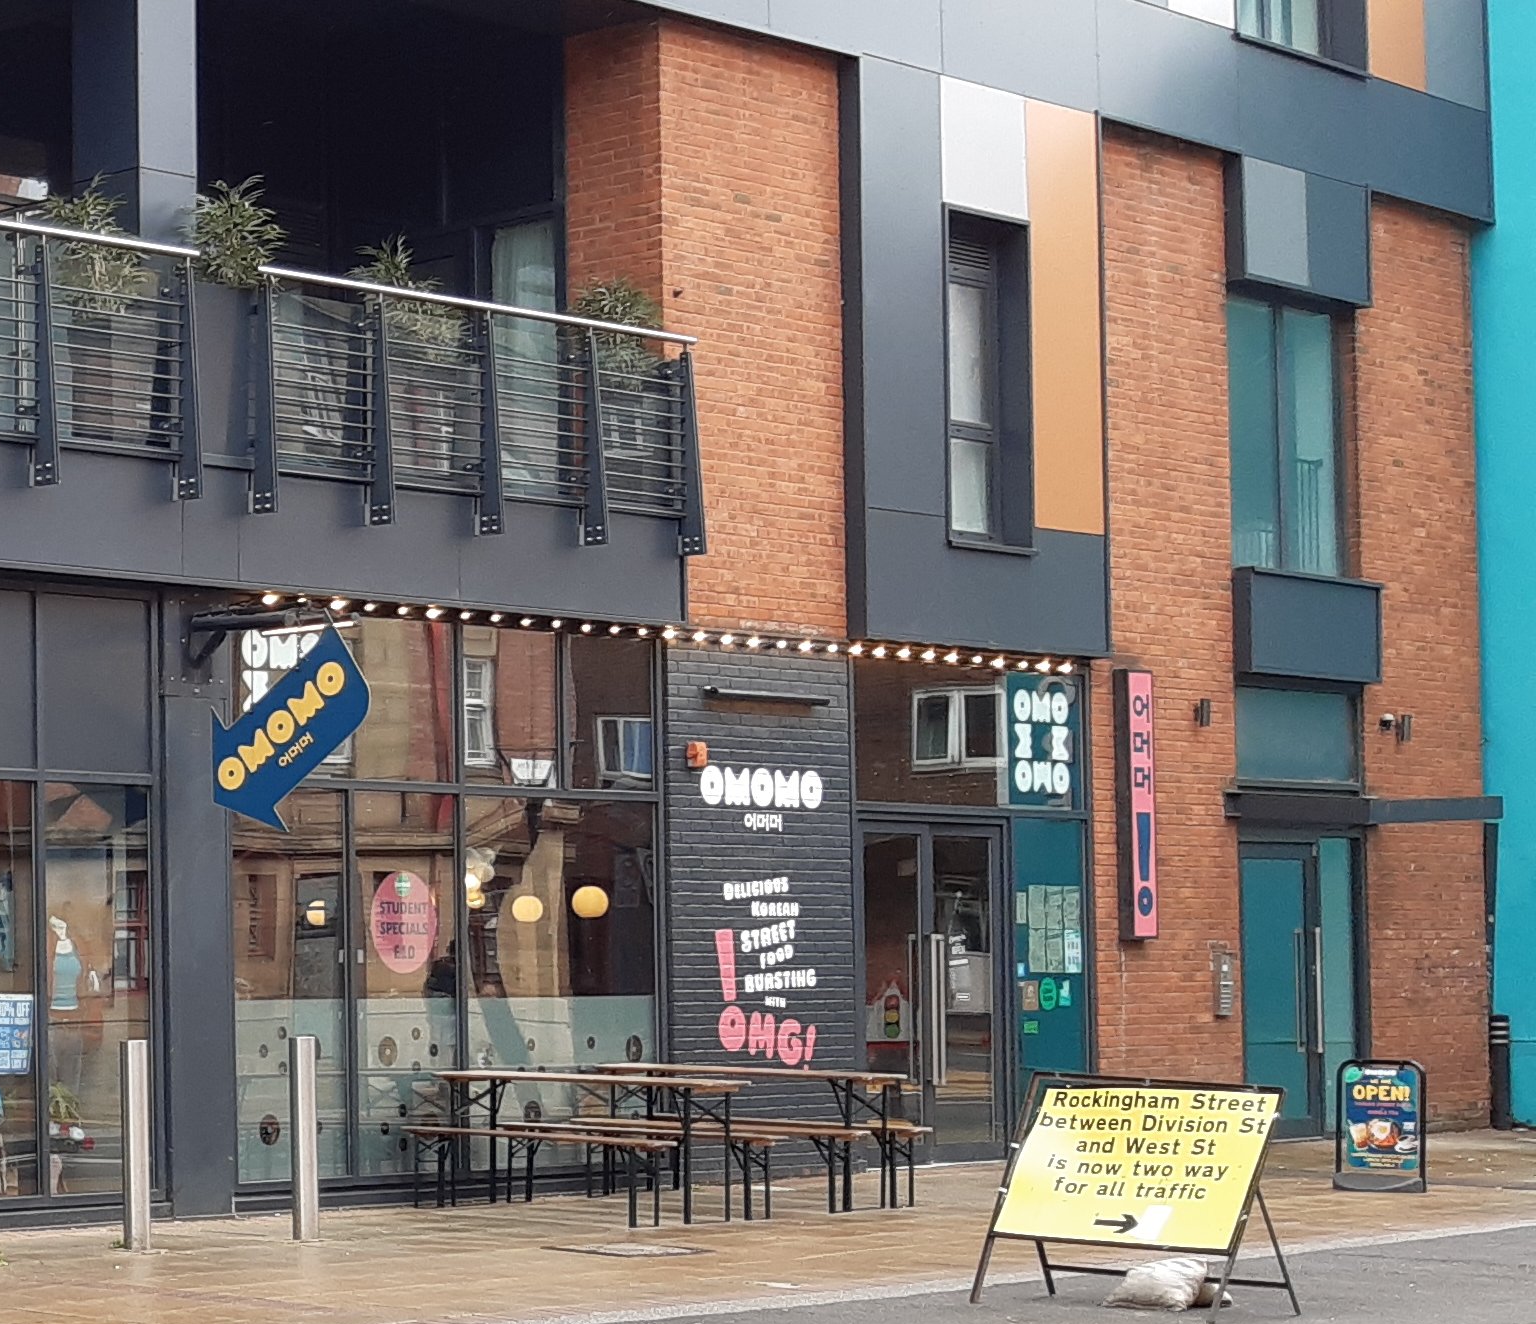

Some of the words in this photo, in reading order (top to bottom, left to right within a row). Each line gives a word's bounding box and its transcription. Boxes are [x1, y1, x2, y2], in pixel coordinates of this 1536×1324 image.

[218, 661, 345, 790] OMOMO
[700, 765, 823, 809] OMOMO
[744, 813, 783, 832] 어머머
[723, 876, 789, 900] DELICIOUS
[380, 902, 428, 914] STUDENT
[751, 901, 799, 917] KOREAN
[380, 922, 428, 934] SPECIALS
[740, 919, 796, 953] STREET
[760, 944, 793, 969] FOOD
[744, 968, 817, 993] BURSTING
[718, 1005, 817, 1071] OMG!
[1053, 1090, 1180, 1111] Rockingham
[1190, 1093, 1266, 1112] Street
[1353, 1085, 1411, 1101] OPEN!
[1039, 1112, 1132, 1132] between
[1141, 1115, 1228, 1133] Division
[1238, 1117, 1267, 1135] St
[1076, 1137, 1115, 1154] and
[1126, 1137, 1181, 1155] West
[1190, 1138, 1216, 1156] St
[1047, 1154, 1068, 1170] is
[1077, 1161, 1122, 1175] now
[1133, 1161, 1173, 1177] two
[1185, 1163, 1229, 1181] way
[1053, 1176, 1088, 1195] for
[1096, 1180, 1125, 1197] all
[1135, 1182, 1207, 1200] traffic
